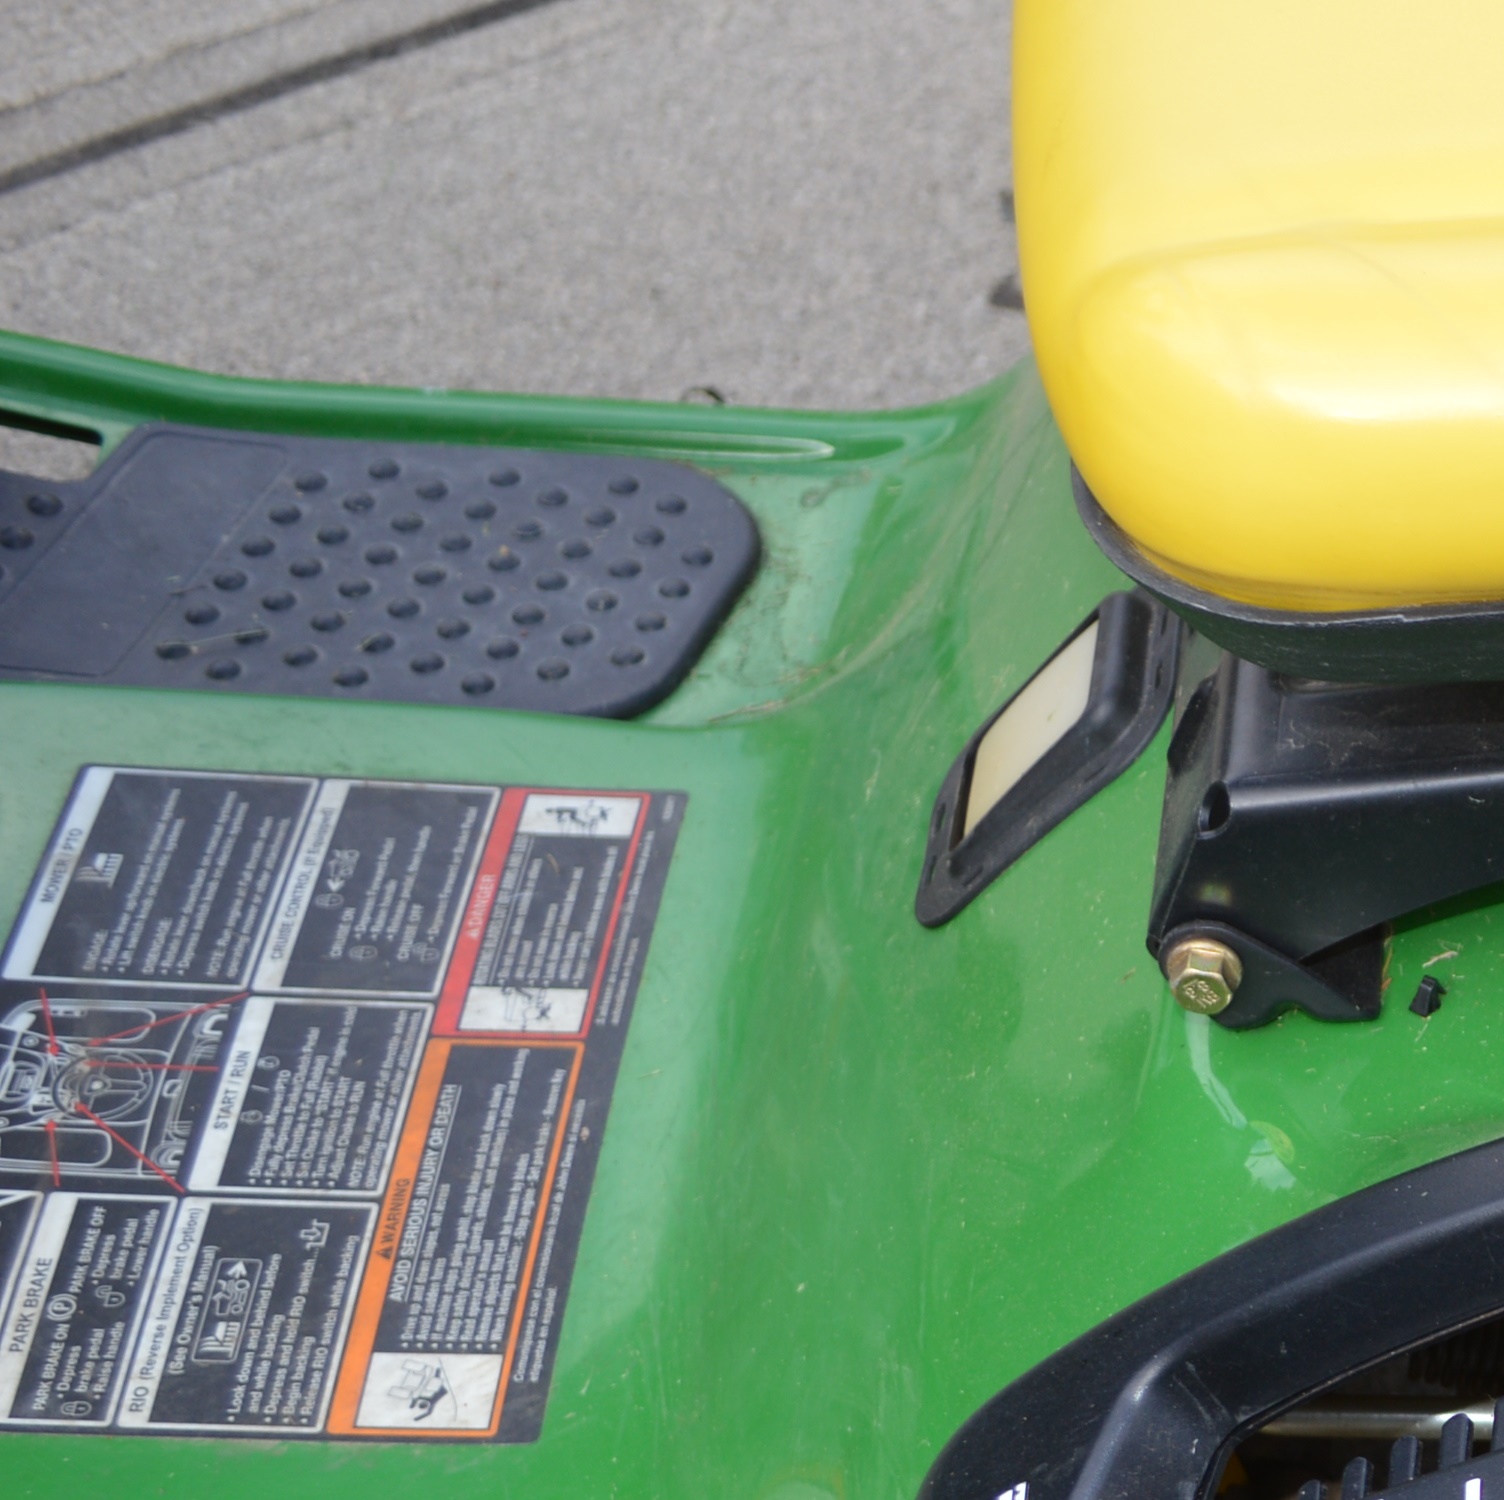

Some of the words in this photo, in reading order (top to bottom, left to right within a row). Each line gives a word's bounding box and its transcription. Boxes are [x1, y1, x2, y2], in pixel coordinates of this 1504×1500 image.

[40, 859, 69, 902] MOWER
[61, 828, 83, 850] PTO
[270, 921, 295, 959] CRUISE
[284, 870, 312, 917] CONTROL
[469, 873, 496, 924] DANGER
[213, 1088, 239, 1129] START
[229, 1050, 250, 1077] RUN
[433, 1083, 457, 1124] DEATH
[427, 1126, 447, 1146] OR
[414, 1148, 441, 1195] INJURY
[89, 1205, 107, 1225] OFF
[136, 1209, 160, 1243] handle
[379, 1177, 411, 1243] WARNING
[398, 1197, 429, 1256] SERIOUS
[77, 1227, 101, 1261] BRAKE
[117, 1218, 141, 1247] pedal
[174, 1207, 205, 1252] Option)
[90, 1234, 117, 1277] Depress
[108, 1249, 130, 1278] brake
[126, 1246, 149, 1278] Lower
[259, 1253, 282, 1287] before
[334, 1235, 360, 1276] backing
[67, 1265, 89, 1292] PARK
[154, 1255, 190, 1319] Implement
[327, 1278, 346, 1306] while
[387, 1259, 413, 1300] AVOID
[8, 1312, 35, 1352] PARK
[22, 1257, 53, 1307] BRAKE
[166, 1347, 191, 1374] (See
[189, 1245, 221, 1291] Manual)
[249, 1289, 272, 1325] behind
[288, 1295, 306, 1316] RIO
[52, 1323, 71, 1339] ON
[83, 1328, 108, 1358] pedal
[101, 1321, 126, 1358] handle
[243, 1328, 261, 1349] and
[258, 1313, 287, 1357] backing
[281, 1319, 300, 1342] hold
[317, 1309, 339, 1344] switch
[40, 1342, 65, 1378] BRAKE
[55, 1345, 84, 1390] Depress
[137, 1324, 170, 1379] (Reverse
[234, 1351, 256, 1382] down
[275, 1344, 293, 1365] and
[290, 1336, 317, 1380] backing
[310, 1346, 329, 1368] RIO
[73, 1361, 96, 1391] brake
[91, 1361, 114, 1392] Raise
[250, 1359, 271, 1388] while
[263, 1367, 290, 1413] Depress
[30, 1380, 53, 1410] PARK
[128, 1386, 150, 1412] RIO
[226, 1385, 247, 1412] Look
[243, 1391, 263, 1412] and
[282, 1382, 305, 1413] Begin
[299, 1370, 324, 1415] Release
